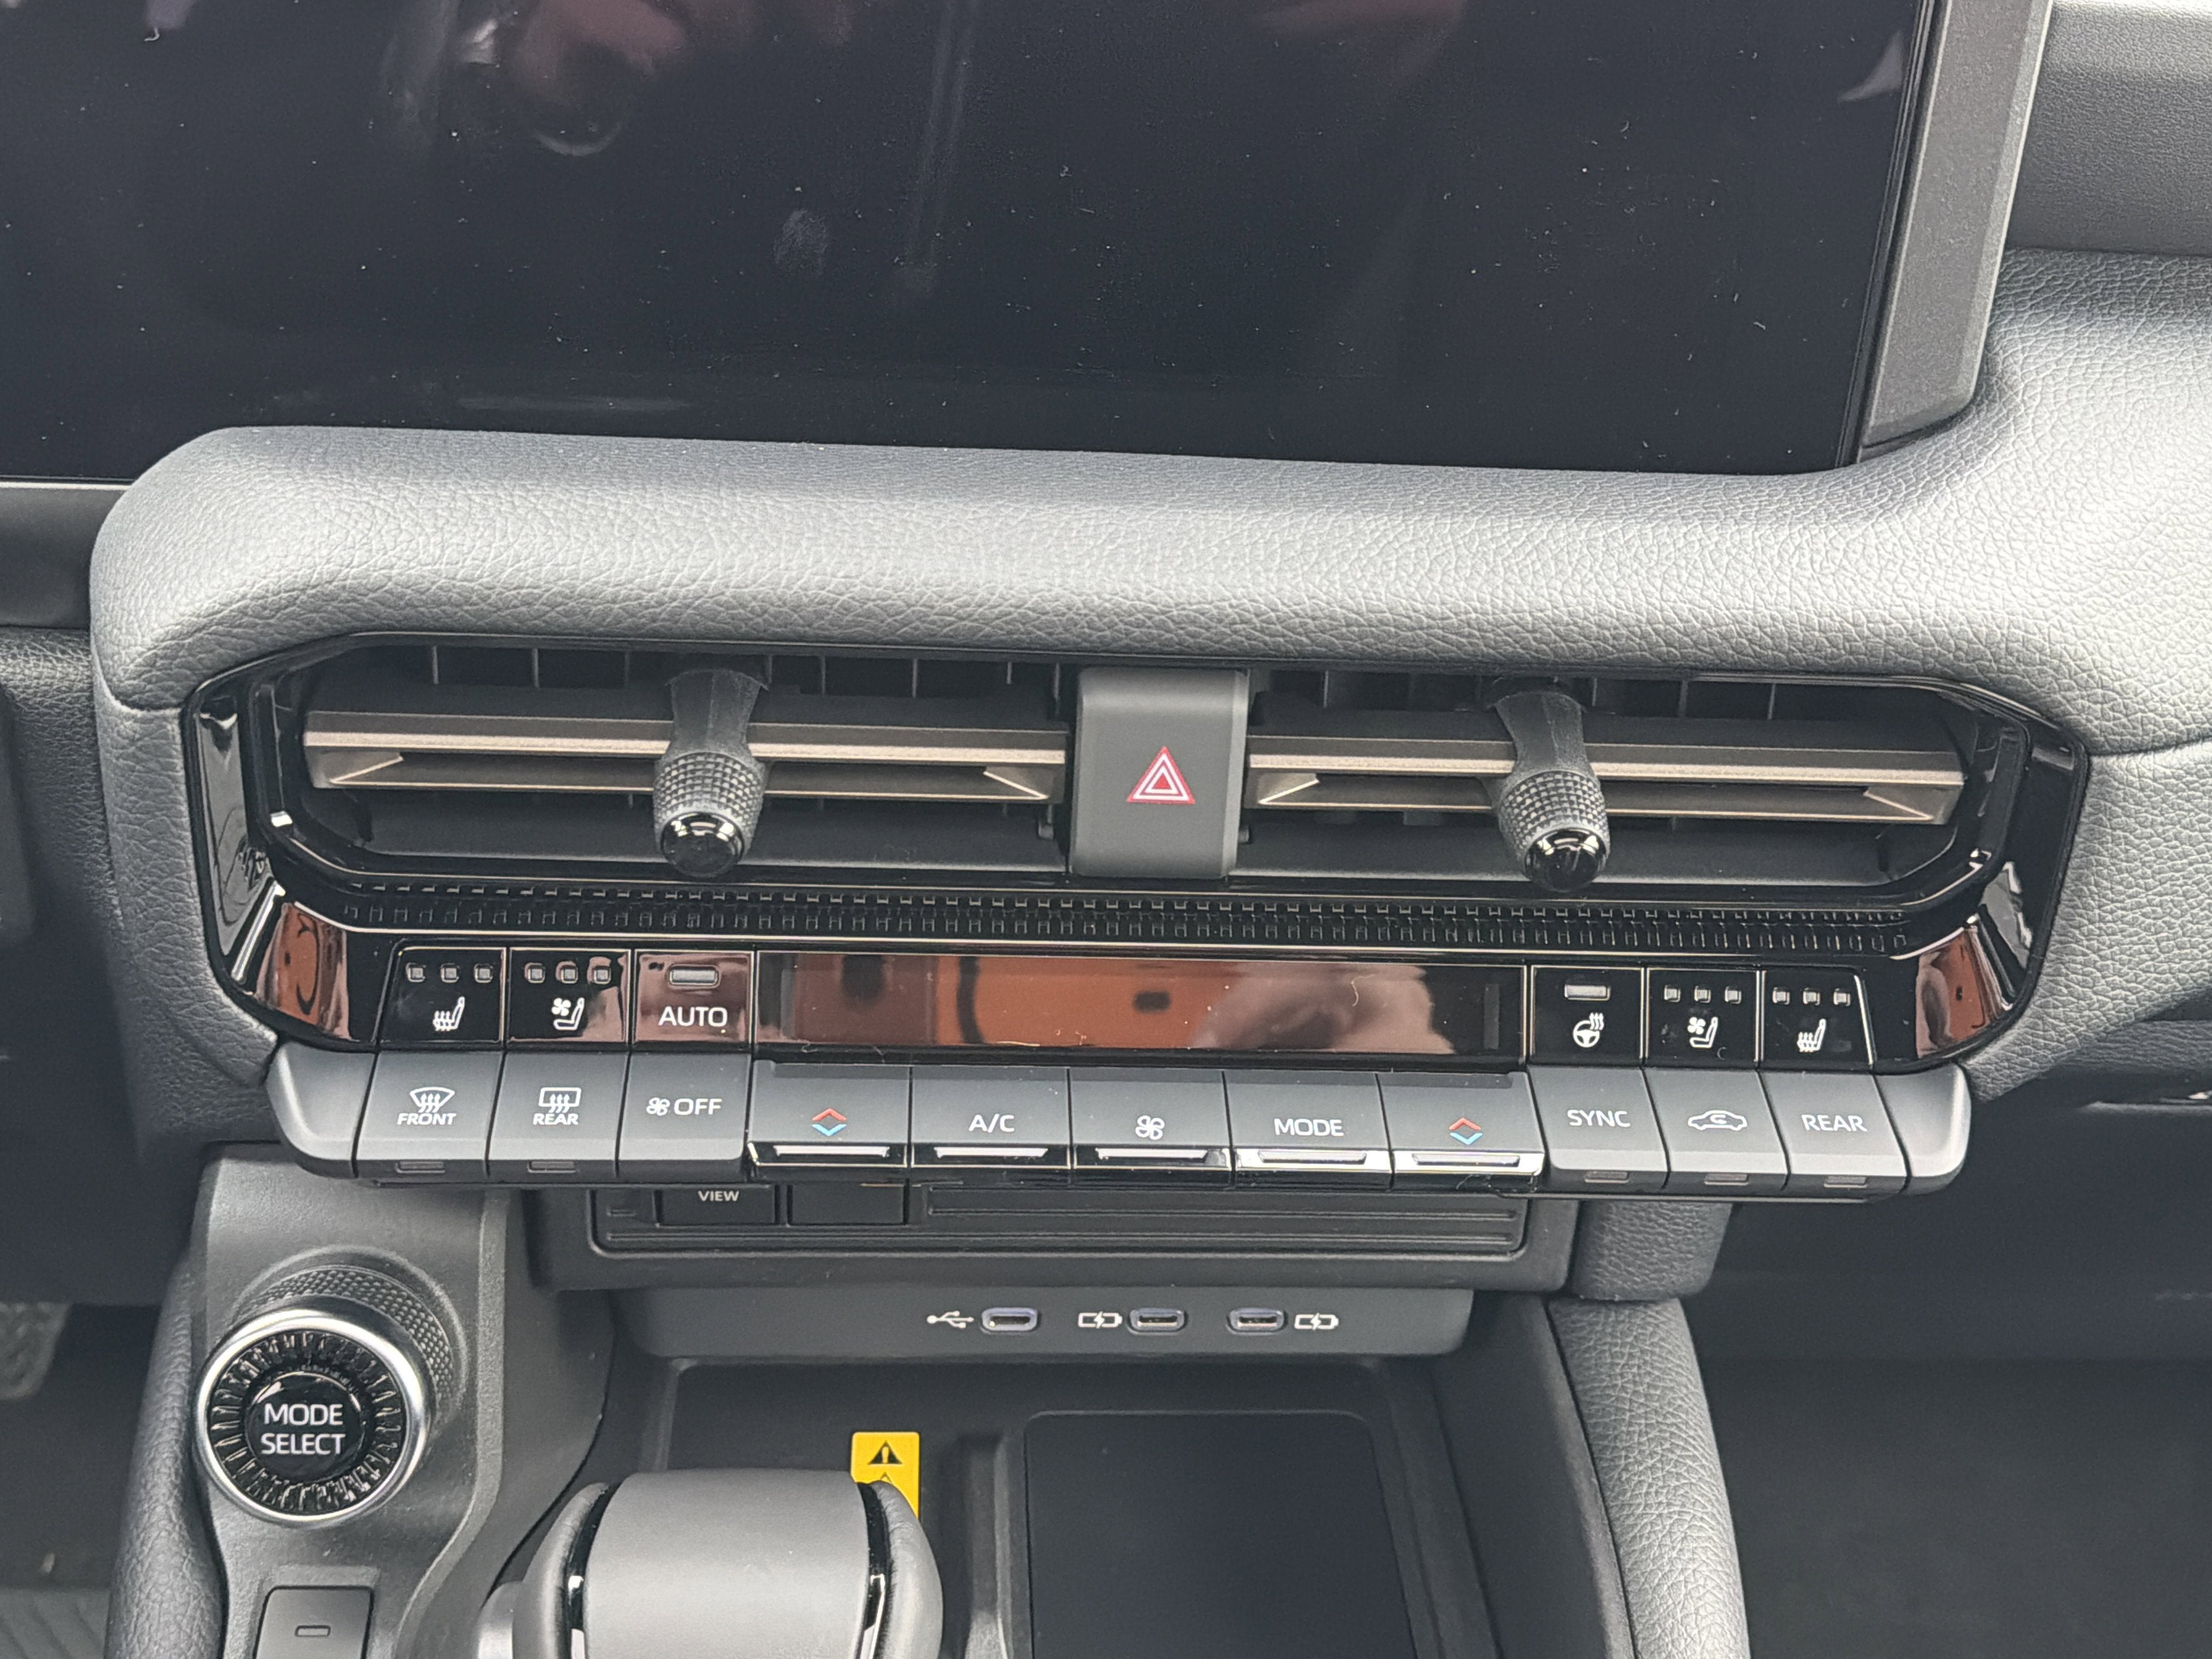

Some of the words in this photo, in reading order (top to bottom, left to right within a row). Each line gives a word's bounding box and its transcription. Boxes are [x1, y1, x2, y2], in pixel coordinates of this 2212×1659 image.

[658, 1006, 728, 1028] AUTO
[674, 1098, 723, 1115] OFF
[397, 1113, 457, 1126] FRONT
[533, 1113, 579, 1126] REAR
[968, 1114, 1015, 1133] A/C
[1274, 1118, 1344, 1137] MODE
[1567, 1109, 1630, 1128] SYNC
[1801, 1114, 1868, 1132] REAR
[698, 1190, 740, 1201] VIEW
[263, 1403, 343, 1426] MODE
[261, 1432, 346, 1455] SELECT
